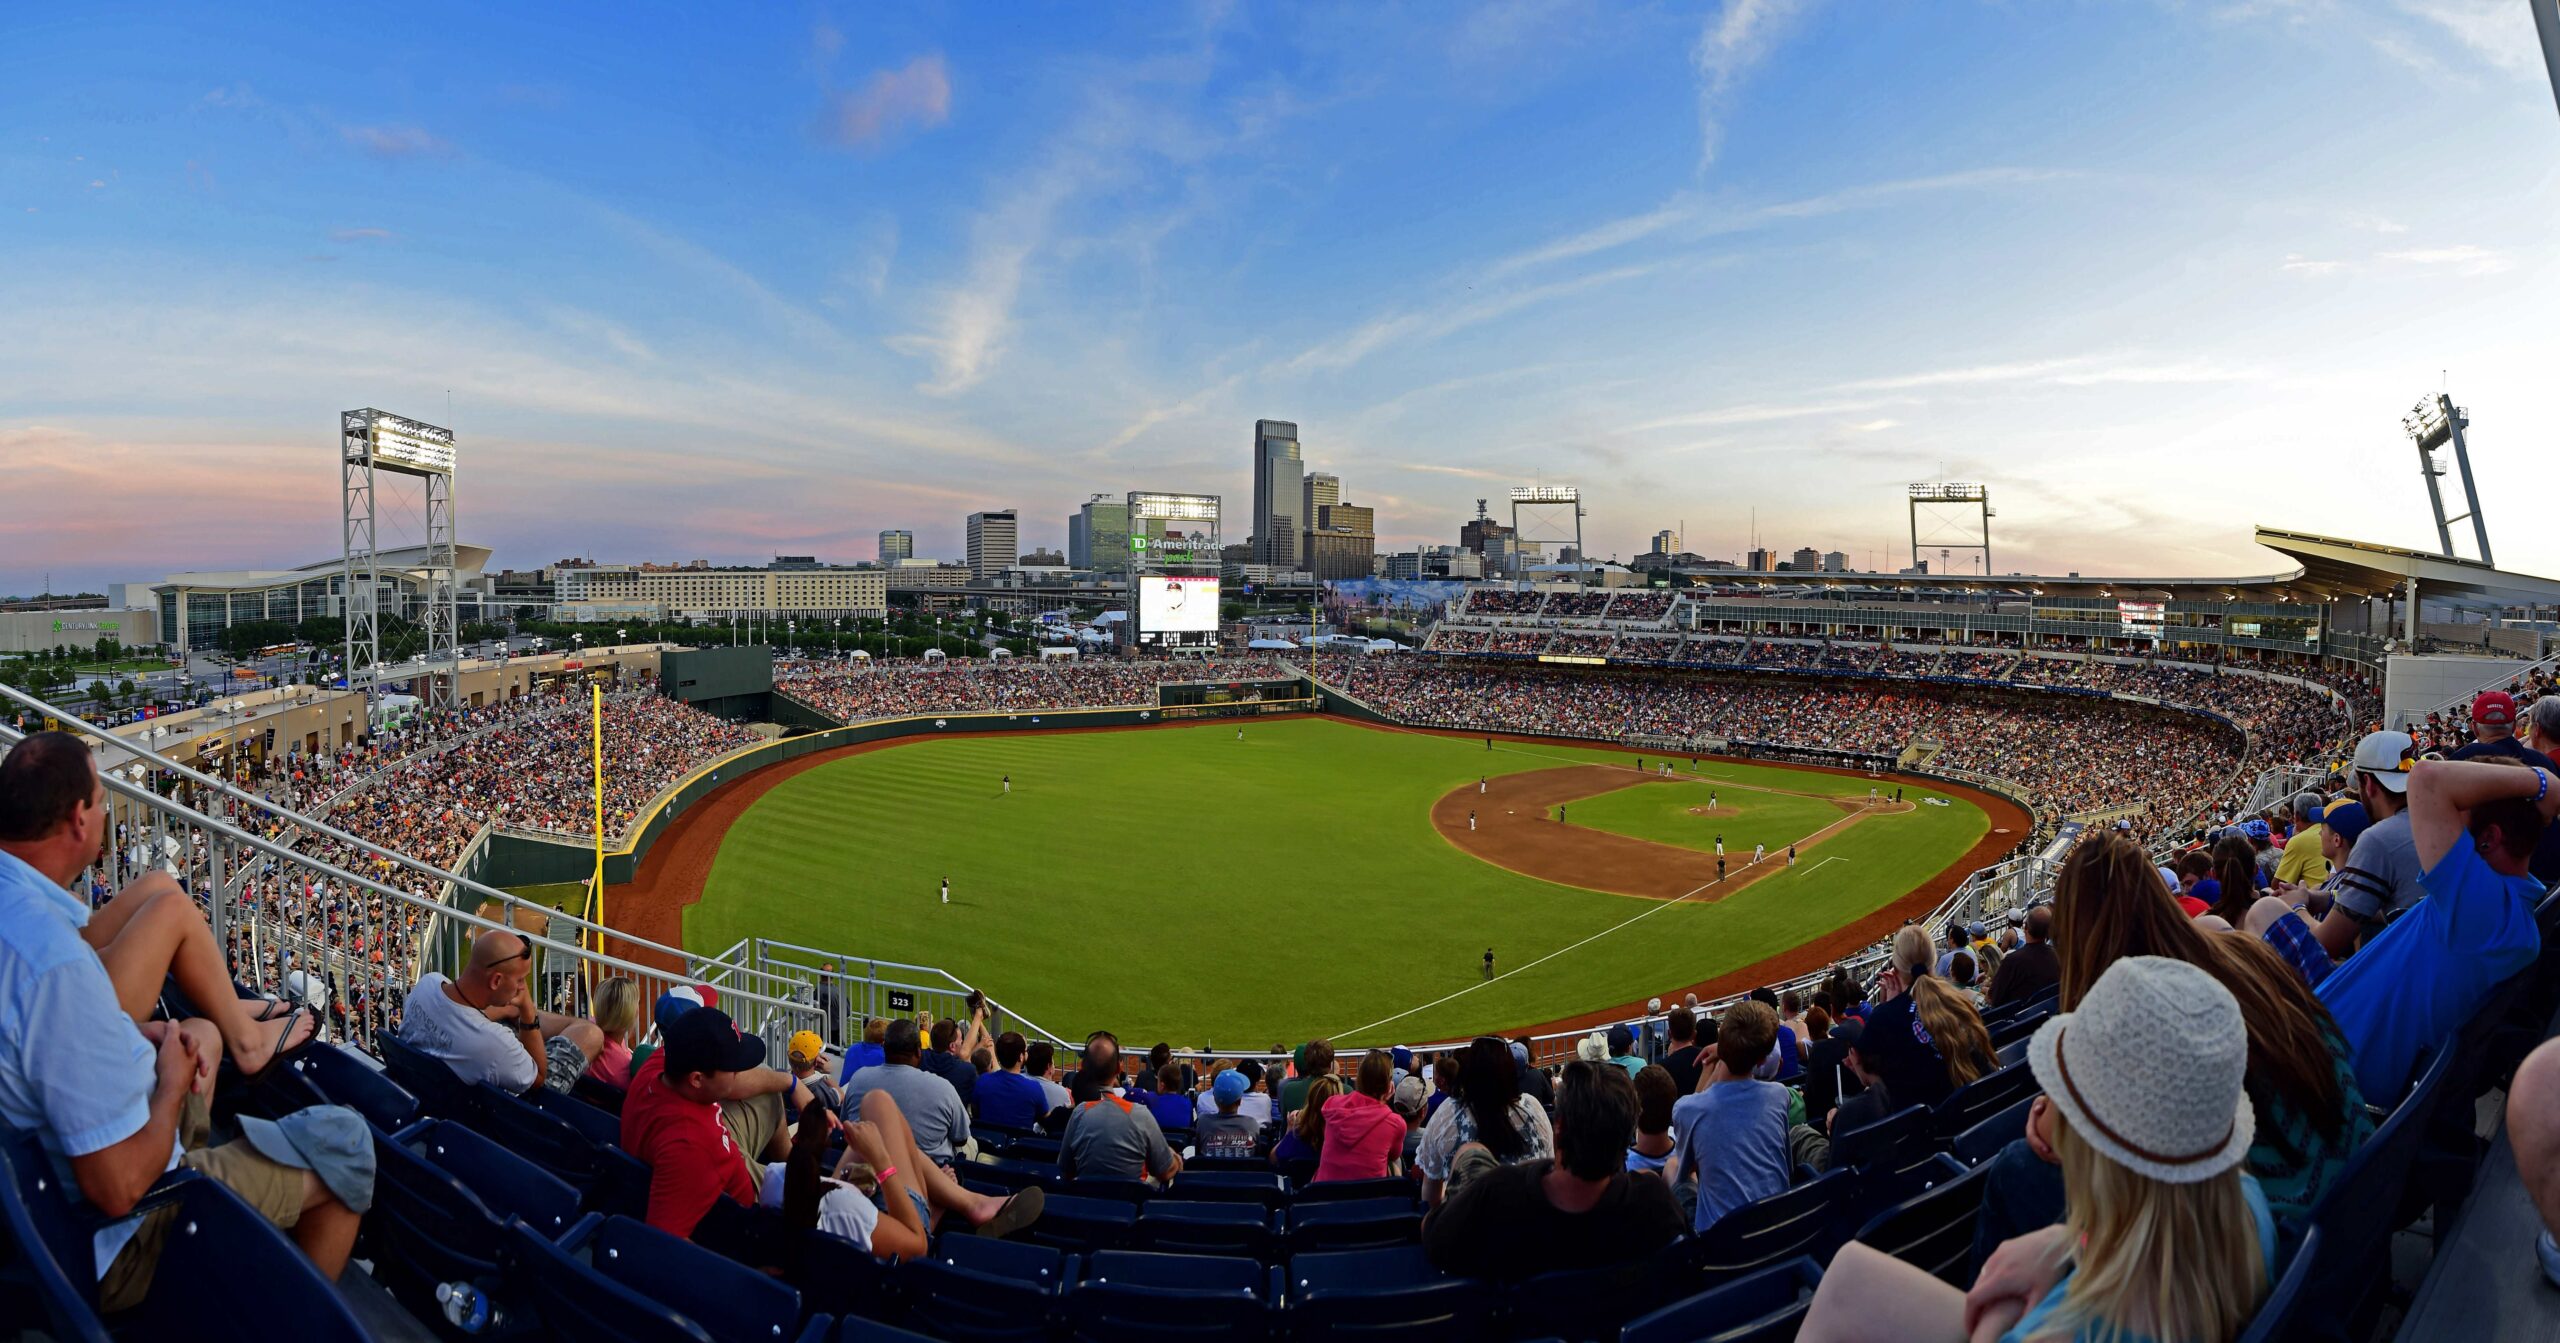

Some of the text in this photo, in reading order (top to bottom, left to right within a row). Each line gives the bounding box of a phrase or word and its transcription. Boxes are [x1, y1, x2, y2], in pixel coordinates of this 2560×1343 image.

[1132, 538, 1226, 551] TD Ameritrade
[1164, 550, 1194, 566] park
[892, 997, 909, 1007] 323
